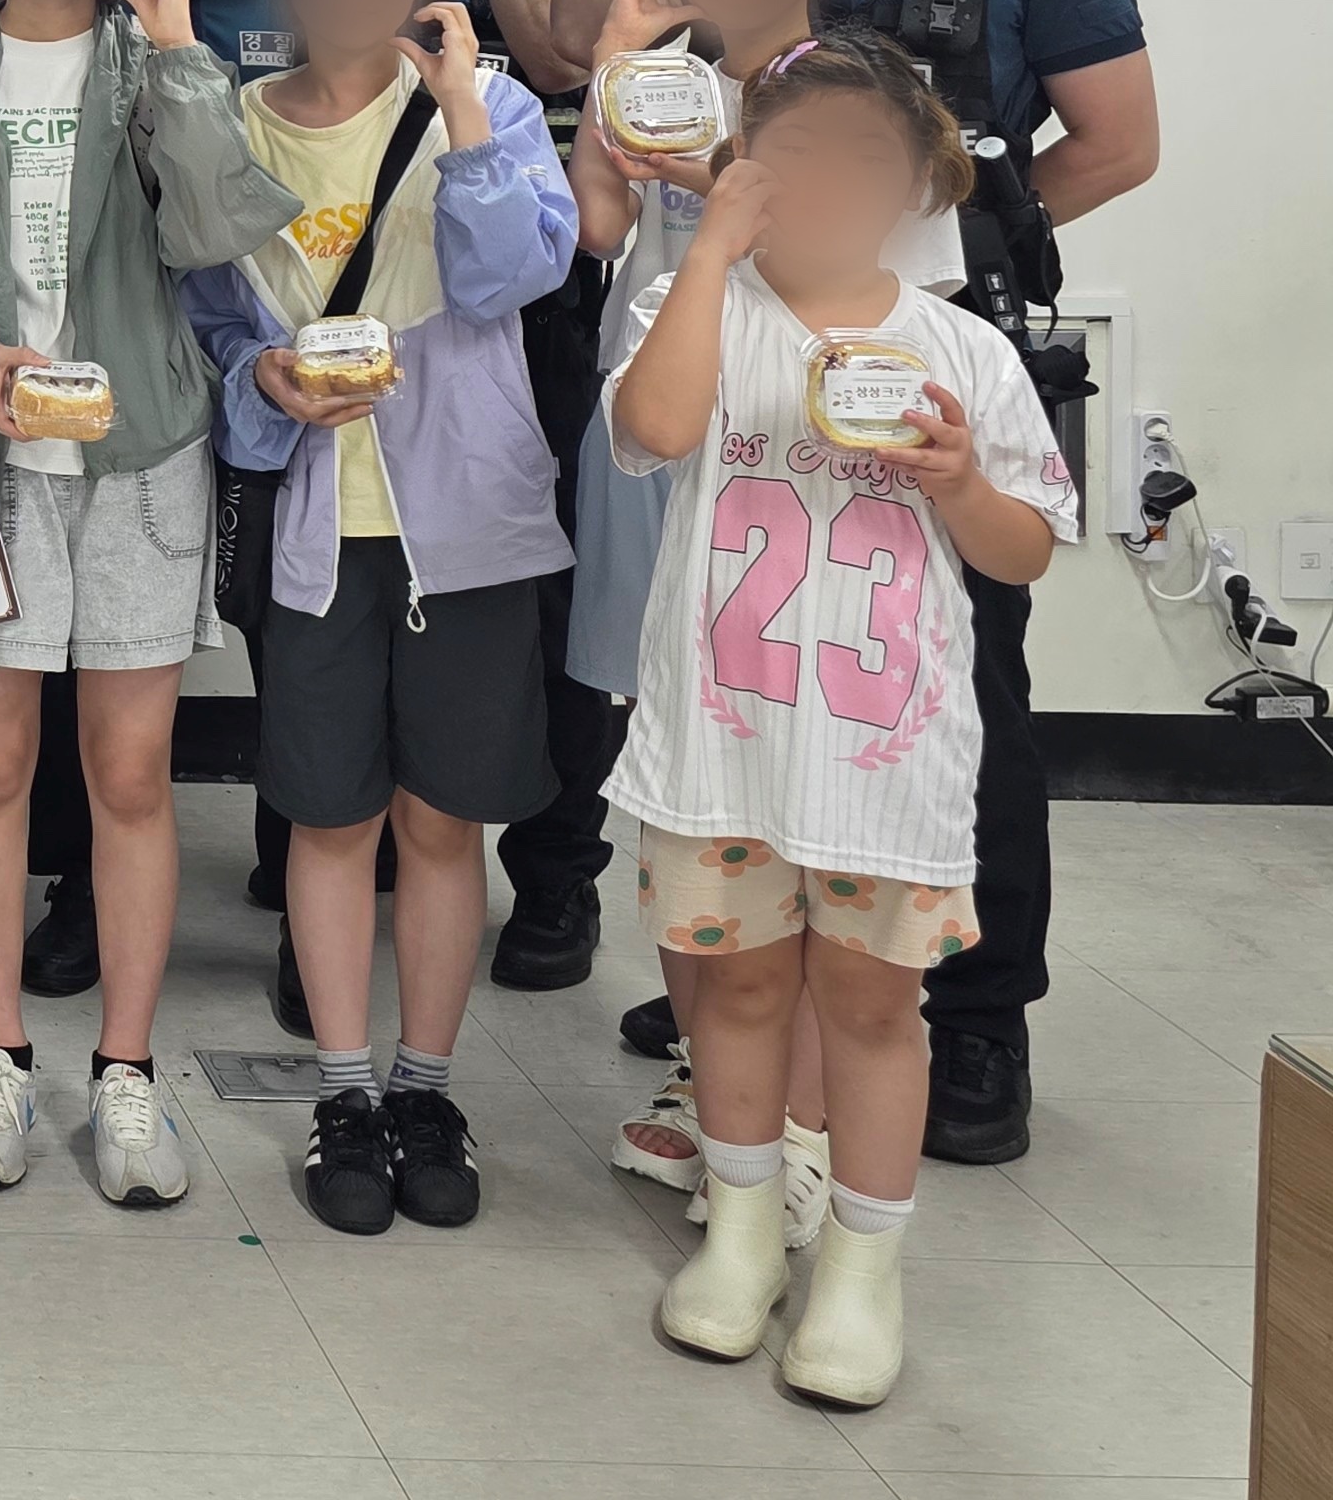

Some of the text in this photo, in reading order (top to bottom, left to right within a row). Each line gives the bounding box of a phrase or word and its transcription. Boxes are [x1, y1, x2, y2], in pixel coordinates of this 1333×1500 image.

[0, 119, 77, 145] ECIP
[291, 203, 371, 245] ESS
[710, 474, 929, 731] 23
